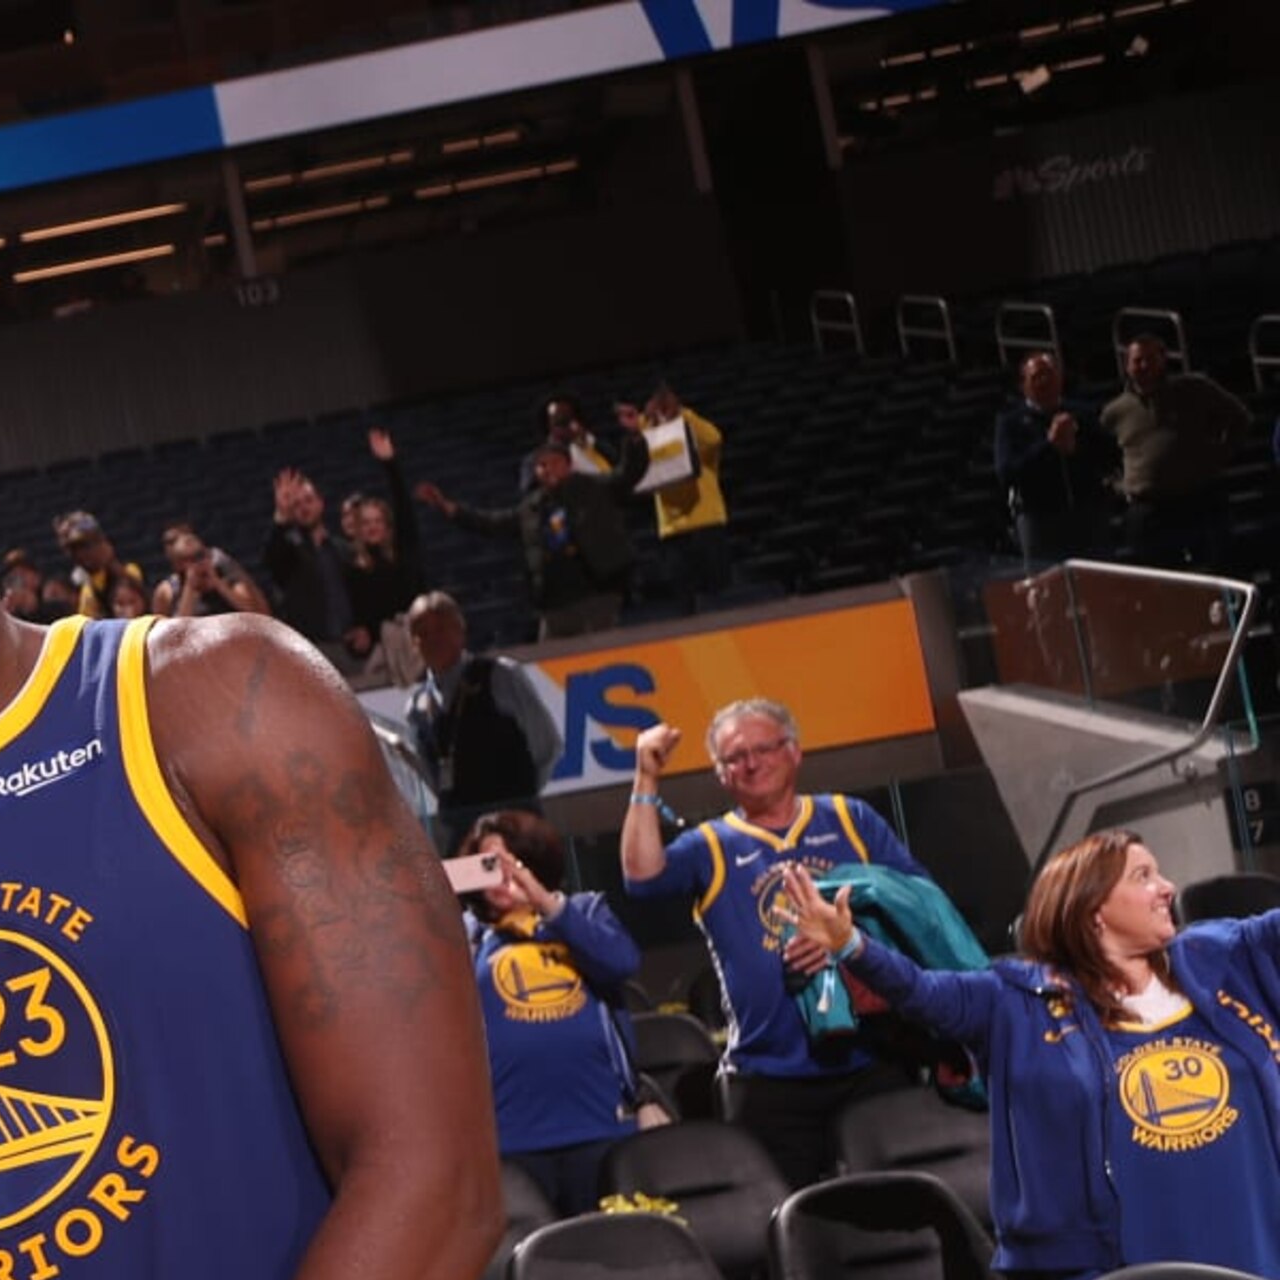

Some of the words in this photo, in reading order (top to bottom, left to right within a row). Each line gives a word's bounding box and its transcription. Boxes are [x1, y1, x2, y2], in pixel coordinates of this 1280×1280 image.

[1244, 787, 1261, 812] 8
[1163, 1055, 1203, 1081] 30
[1131, 1105, 1239, 1152] WARRIORS
